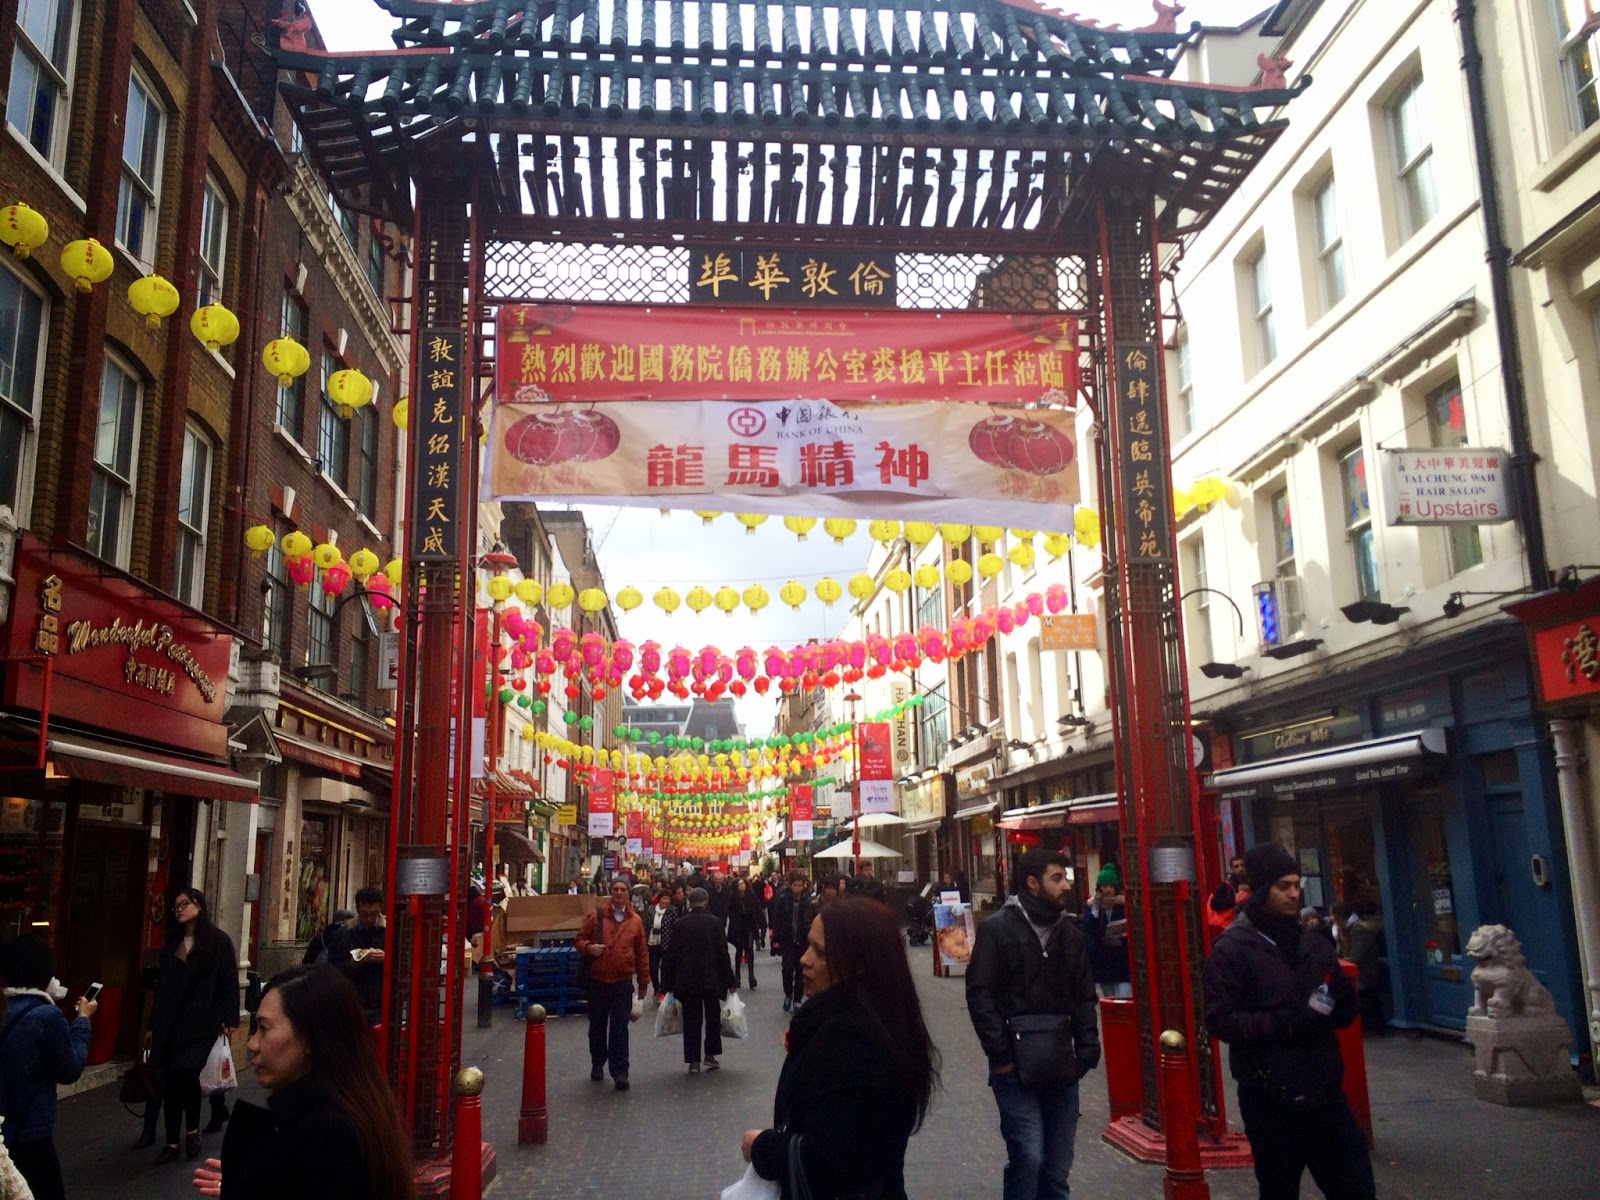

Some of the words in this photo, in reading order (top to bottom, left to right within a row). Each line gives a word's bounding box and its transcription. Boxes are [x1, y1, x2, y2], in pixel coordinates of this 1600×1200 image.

[776, 430, 807, 440] BANK
[809, 427, 823, 436] OF
[826, 425, 864, 436] CHINA
[647, 440, 930, 488] 龍馬精神
[1404, 474, 1423, 484] TAI
[1426, 473, 1467, 483] CHUNG
[1470, 473, 1496, 482] WAH
[1416, 487, 1446, 496] HAIR
[1450, 486, 1486, 496] SALON
[1415, 499, 1499, 520] Upstairs
[67, 616, 159, 654] Wonderful
[895, 687, 906, 747] HAHAN
[1381, 766, 1396, 777] Good
